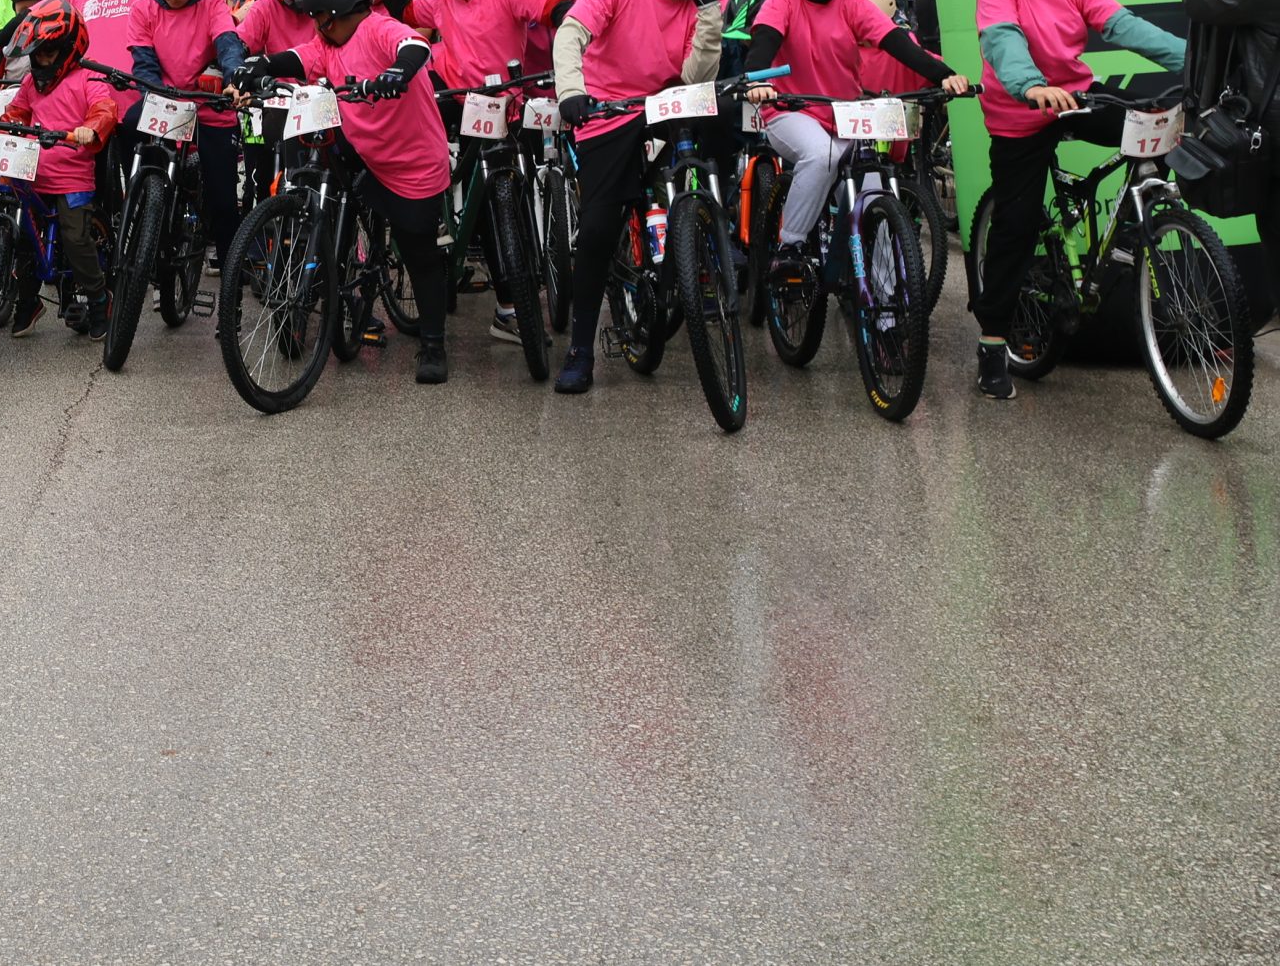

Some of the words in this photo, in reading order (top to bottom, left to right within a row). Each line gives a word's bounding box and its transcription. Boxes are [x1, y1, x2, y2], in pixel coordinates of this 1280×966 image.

[658, 100, 683, 117] 58
[147, 117, 169, 134] 28
[292, 114, 303, 131] 7
[471, 119, 494, 135] 40
[533, 112, 553, 128] 24
[848, 118, 874, 135] 75
[1136, 137, 1162, 154] 17
